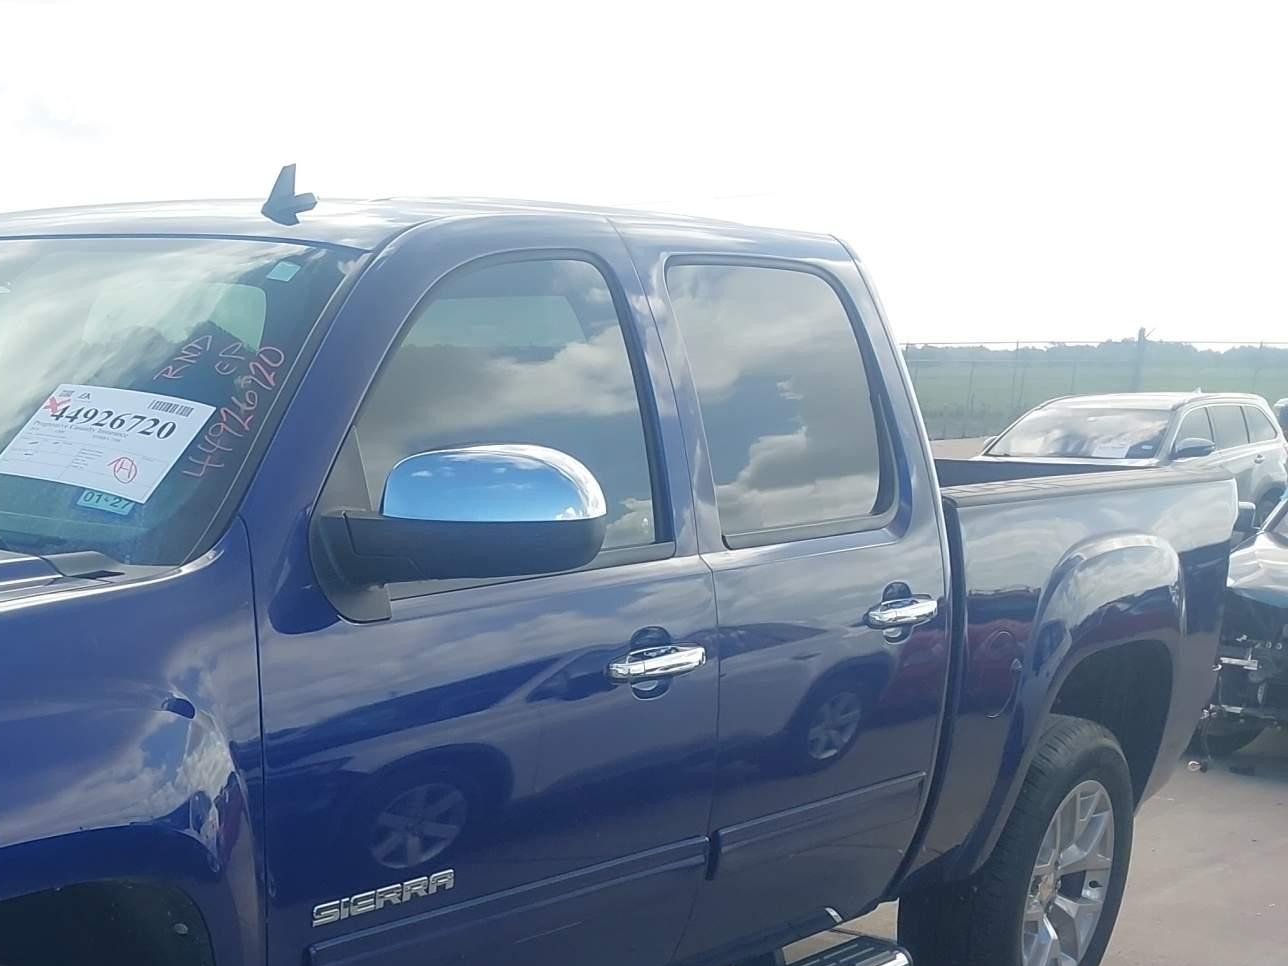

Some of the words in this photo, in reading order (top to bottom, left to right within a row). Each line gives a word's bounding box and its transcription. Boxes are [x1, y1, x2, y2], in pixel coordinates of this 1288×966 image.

[50, 405, 177, 440] 44926720
[182, 346, 285, 477] 44926720
[312, 868, 455, 928] SIERRA
